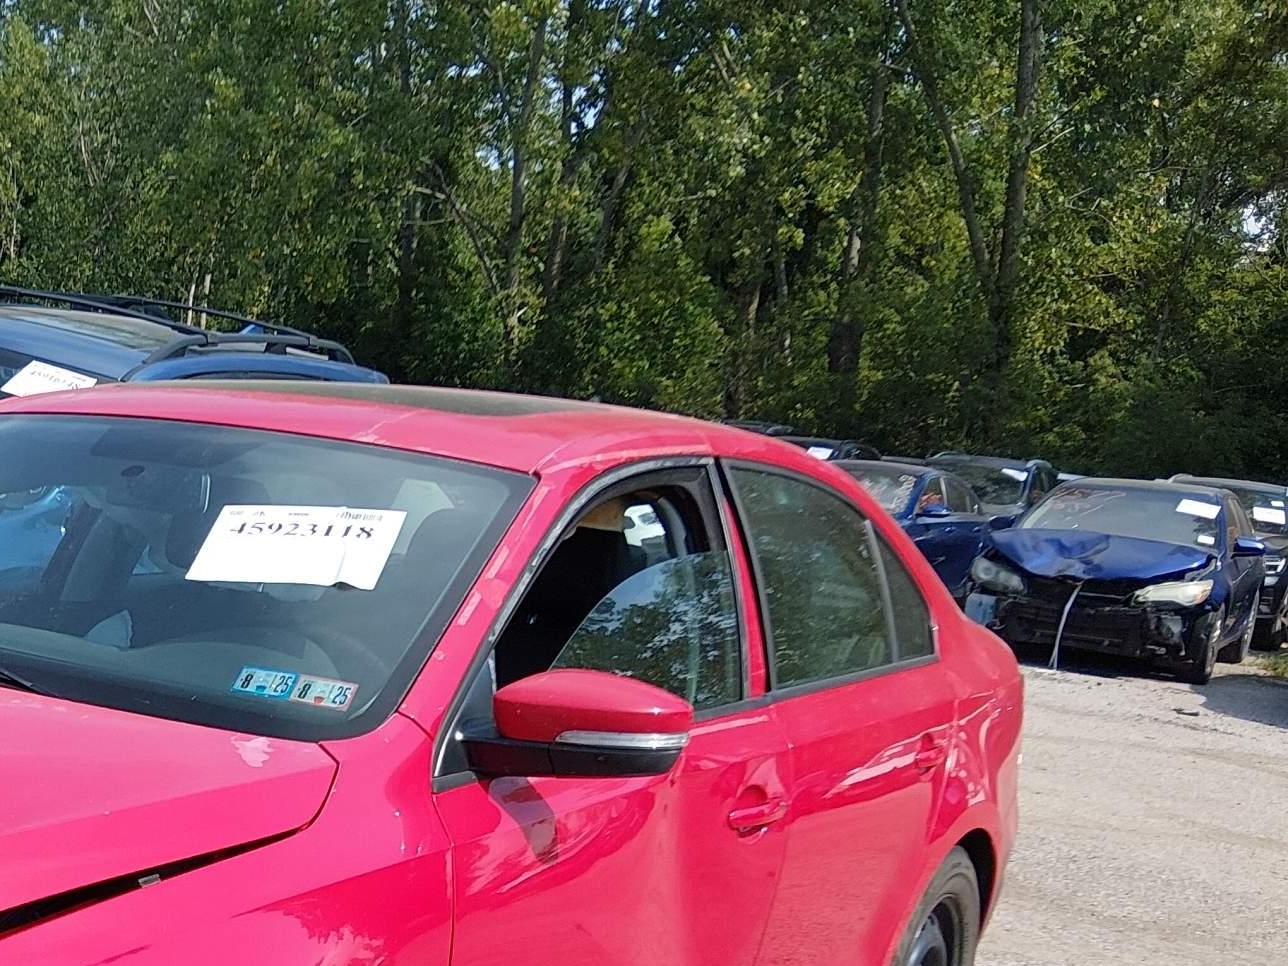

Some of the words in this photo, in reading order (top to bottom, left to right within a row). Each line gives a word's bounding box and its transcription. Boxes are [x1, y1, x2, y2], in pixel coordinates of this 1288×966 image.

[229, 521, 374, 539] 45923118
[273, 675, 293, 694] 25
[332, 686, 352, 705] 25
